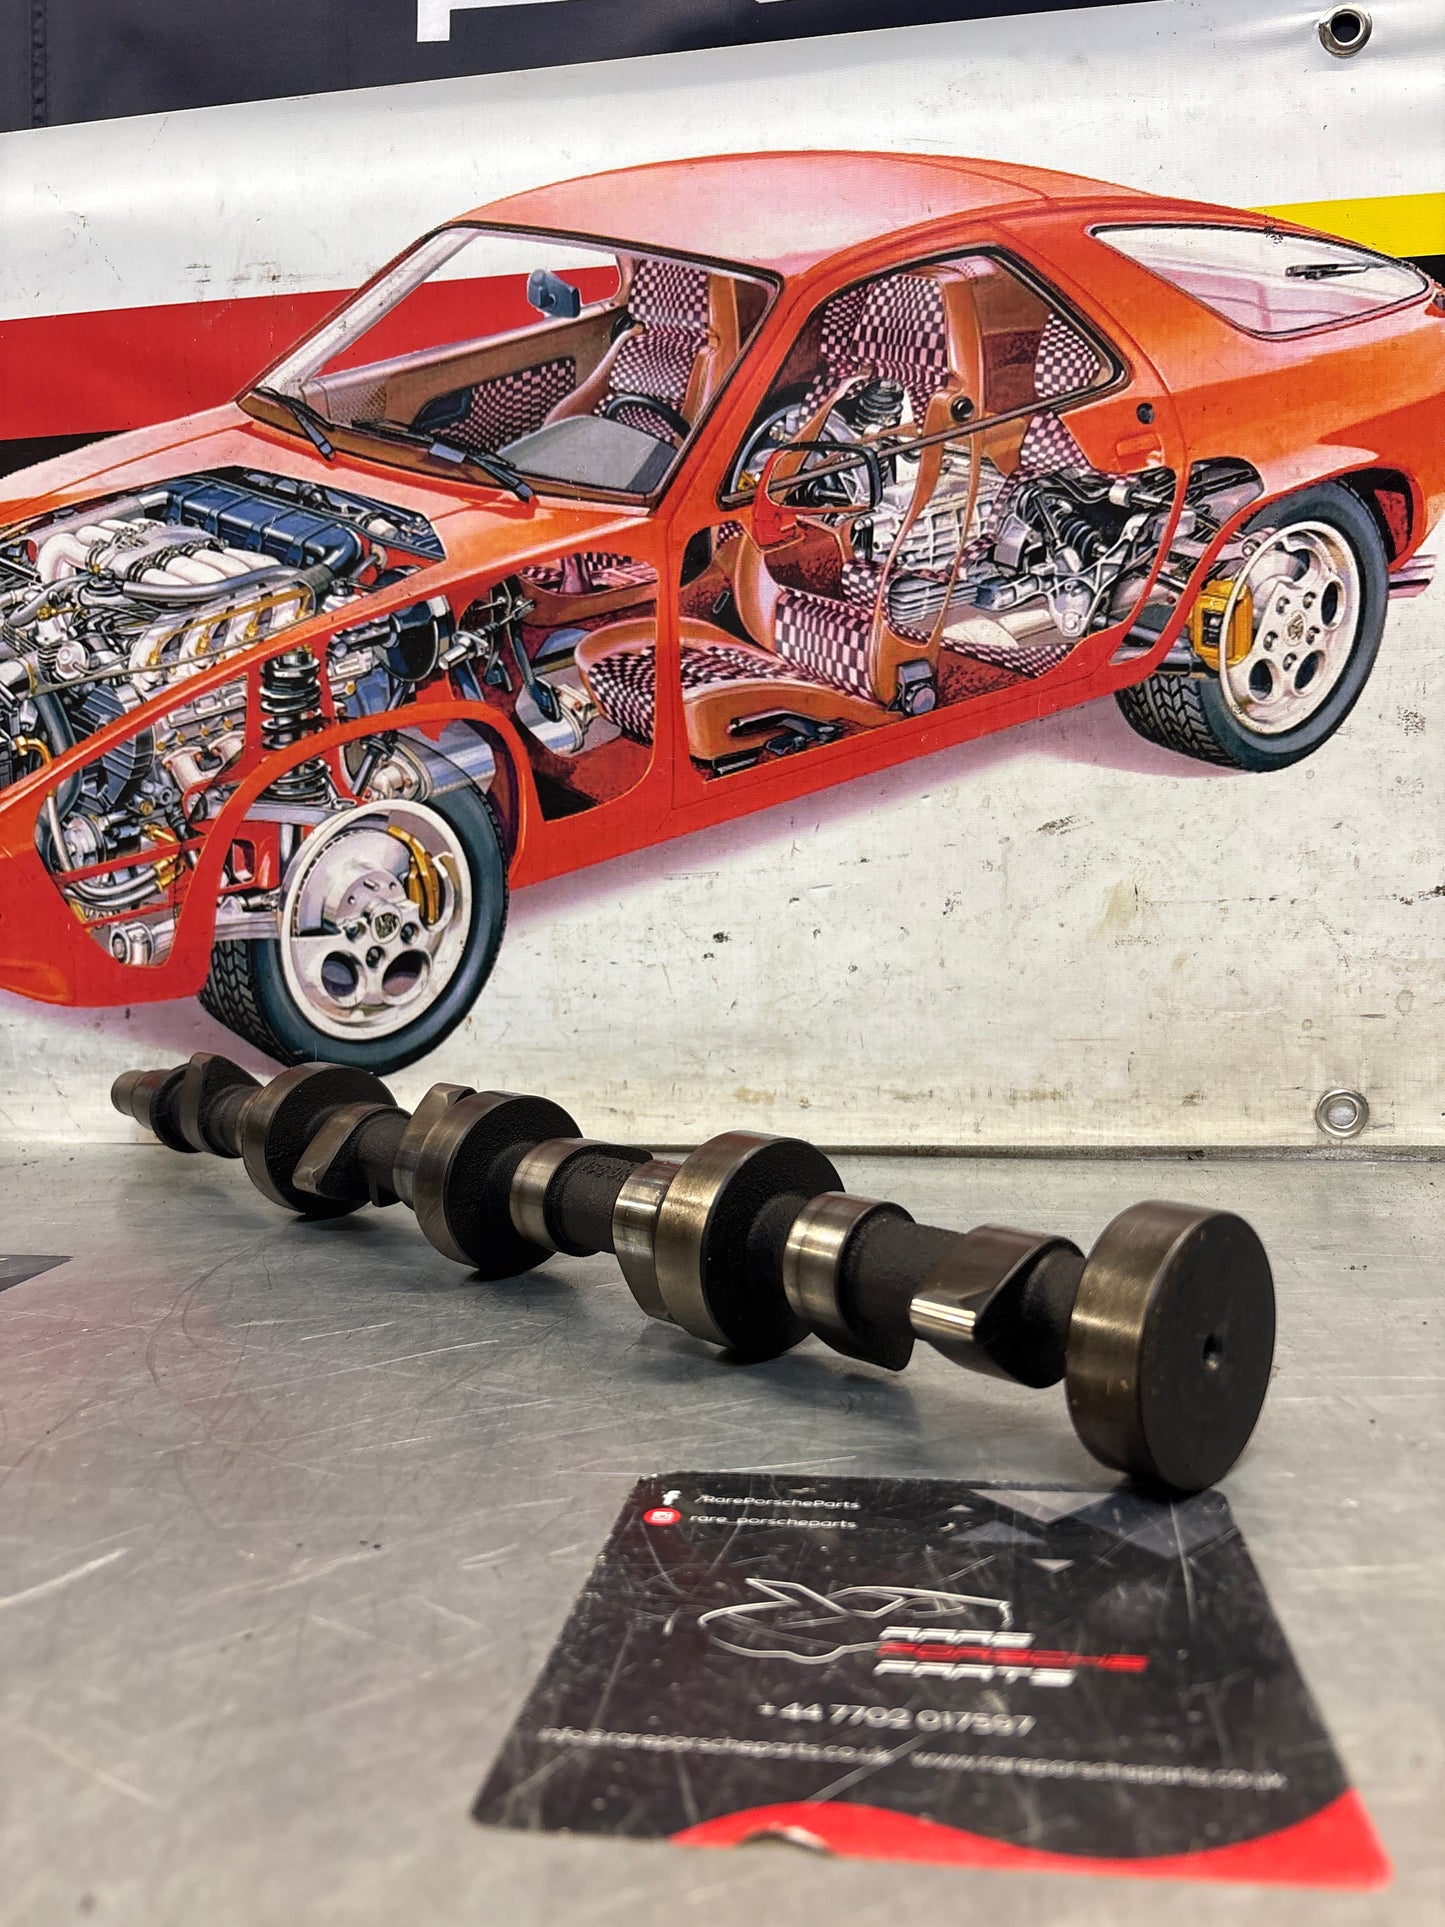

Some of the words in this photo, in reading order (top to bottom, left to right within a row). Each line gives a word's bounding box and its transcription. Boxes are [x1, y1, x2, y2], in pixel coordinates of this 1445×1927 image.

[694, 1494, 861, 1510] /RarePorscheParts
[690, 1514, 857, 1529] rare_porscheparts
[756, 1702, 823, 1722] +44
[829, 1704, 913, 1730] 7702
